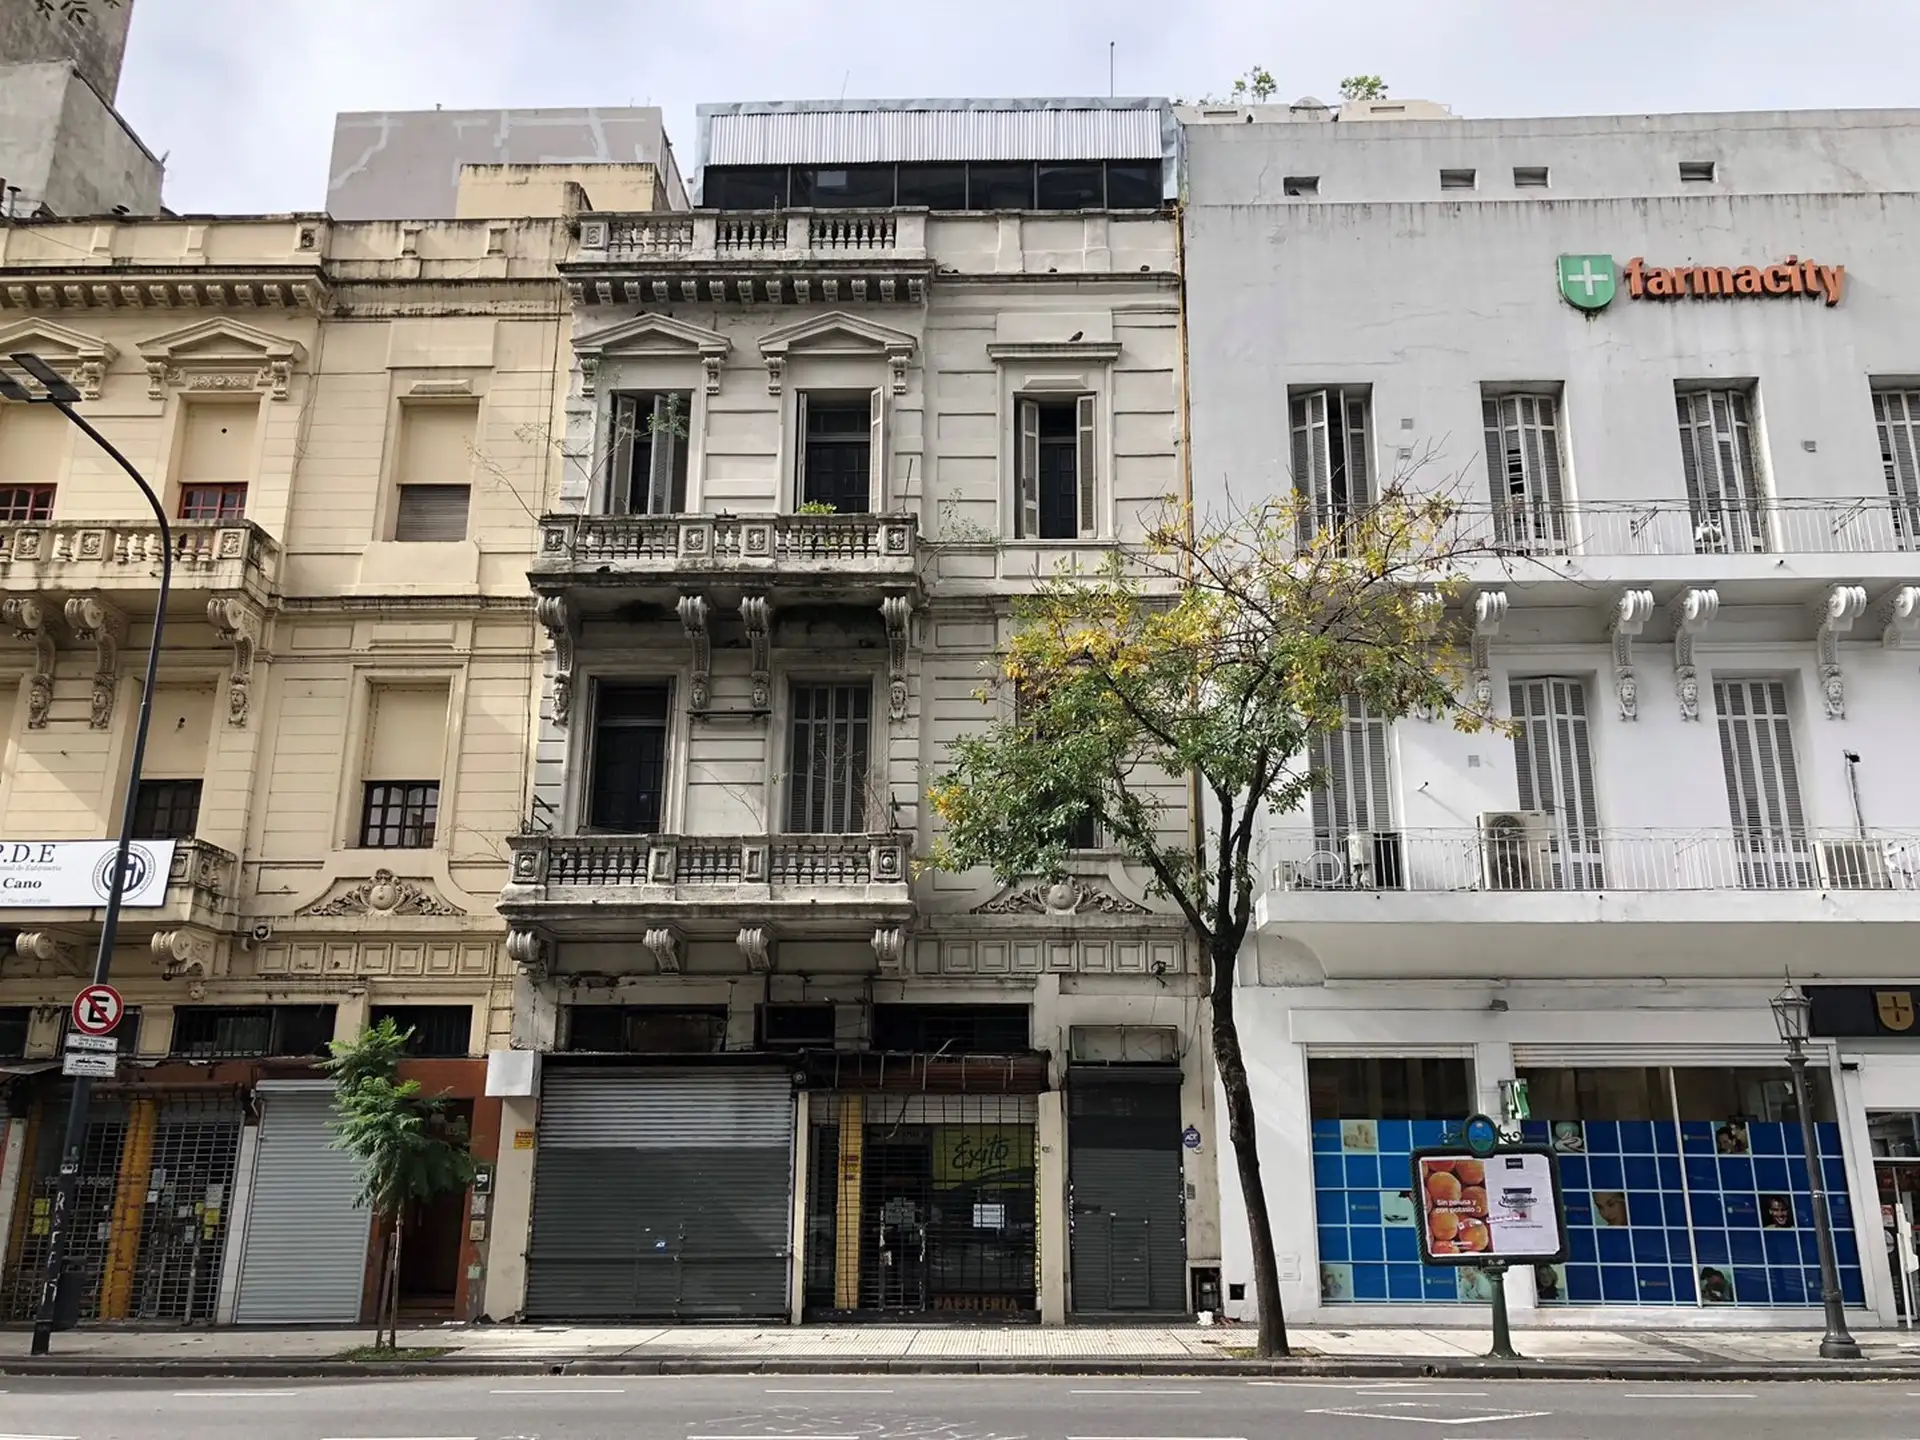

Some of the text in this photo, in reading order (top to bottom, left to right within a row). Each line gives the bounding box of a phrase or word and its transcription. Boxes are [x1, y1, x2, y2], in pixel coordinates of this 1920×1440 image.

[1624, 254, 1845, 306] farmacity
[0, 844, 56, 863] .D.E
[3, 877, 42, 889] Cano
[88, 996, 110, 1023] E
